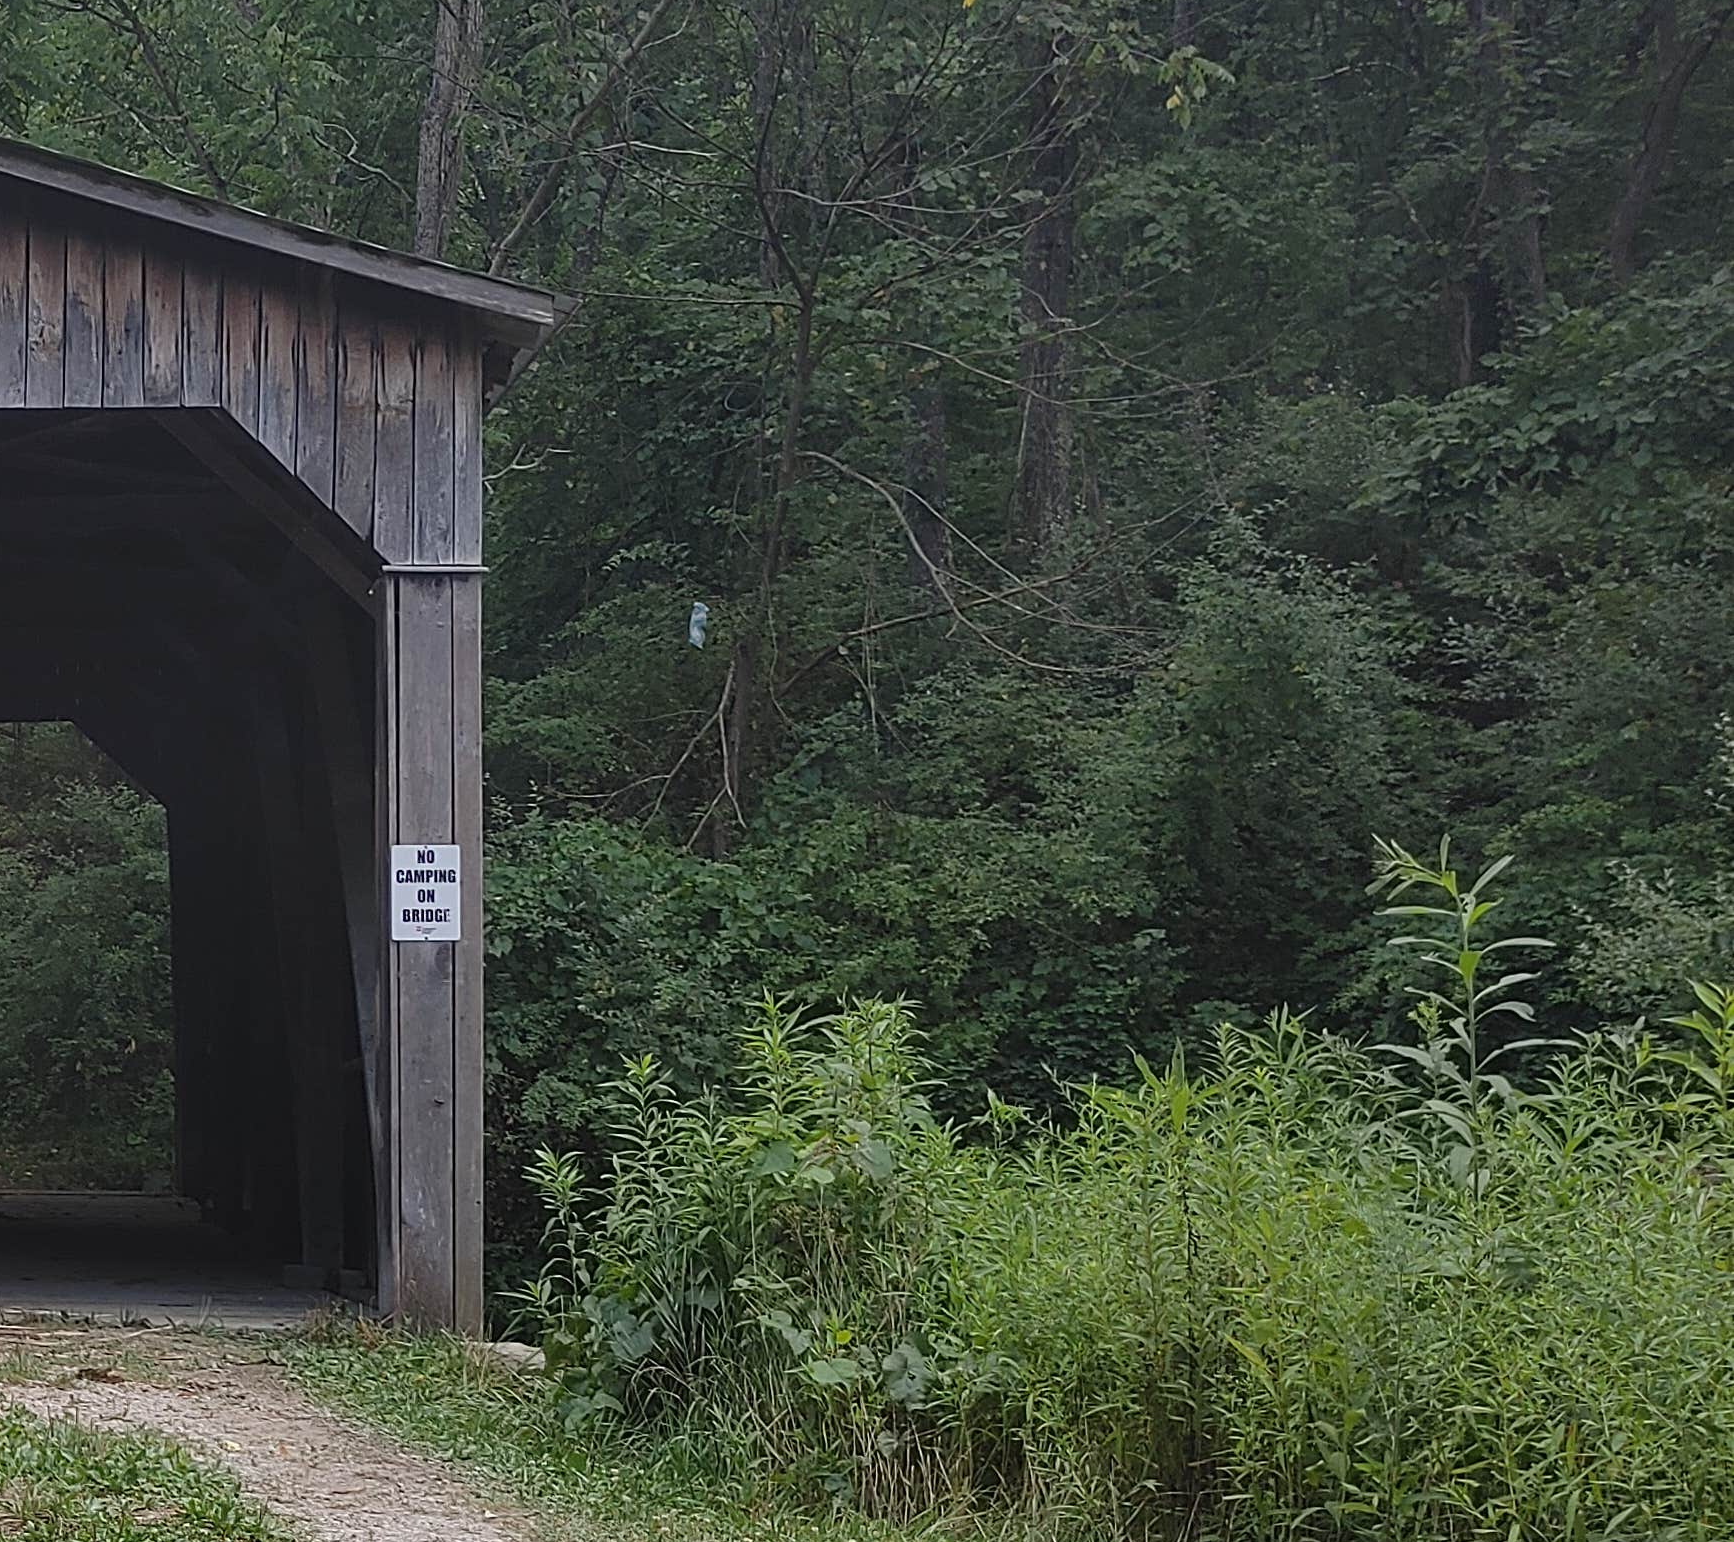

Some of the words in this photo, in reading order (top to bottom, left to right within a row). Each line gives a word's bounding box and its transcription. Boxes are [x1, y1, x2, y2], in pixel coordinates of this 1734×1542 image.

[417, 850, 435, 864] NO
[396, 869, 456, 883] CAMPING
[417, 889, 435, 903] ON
[402, 908, 451, 923] BRIDGE
